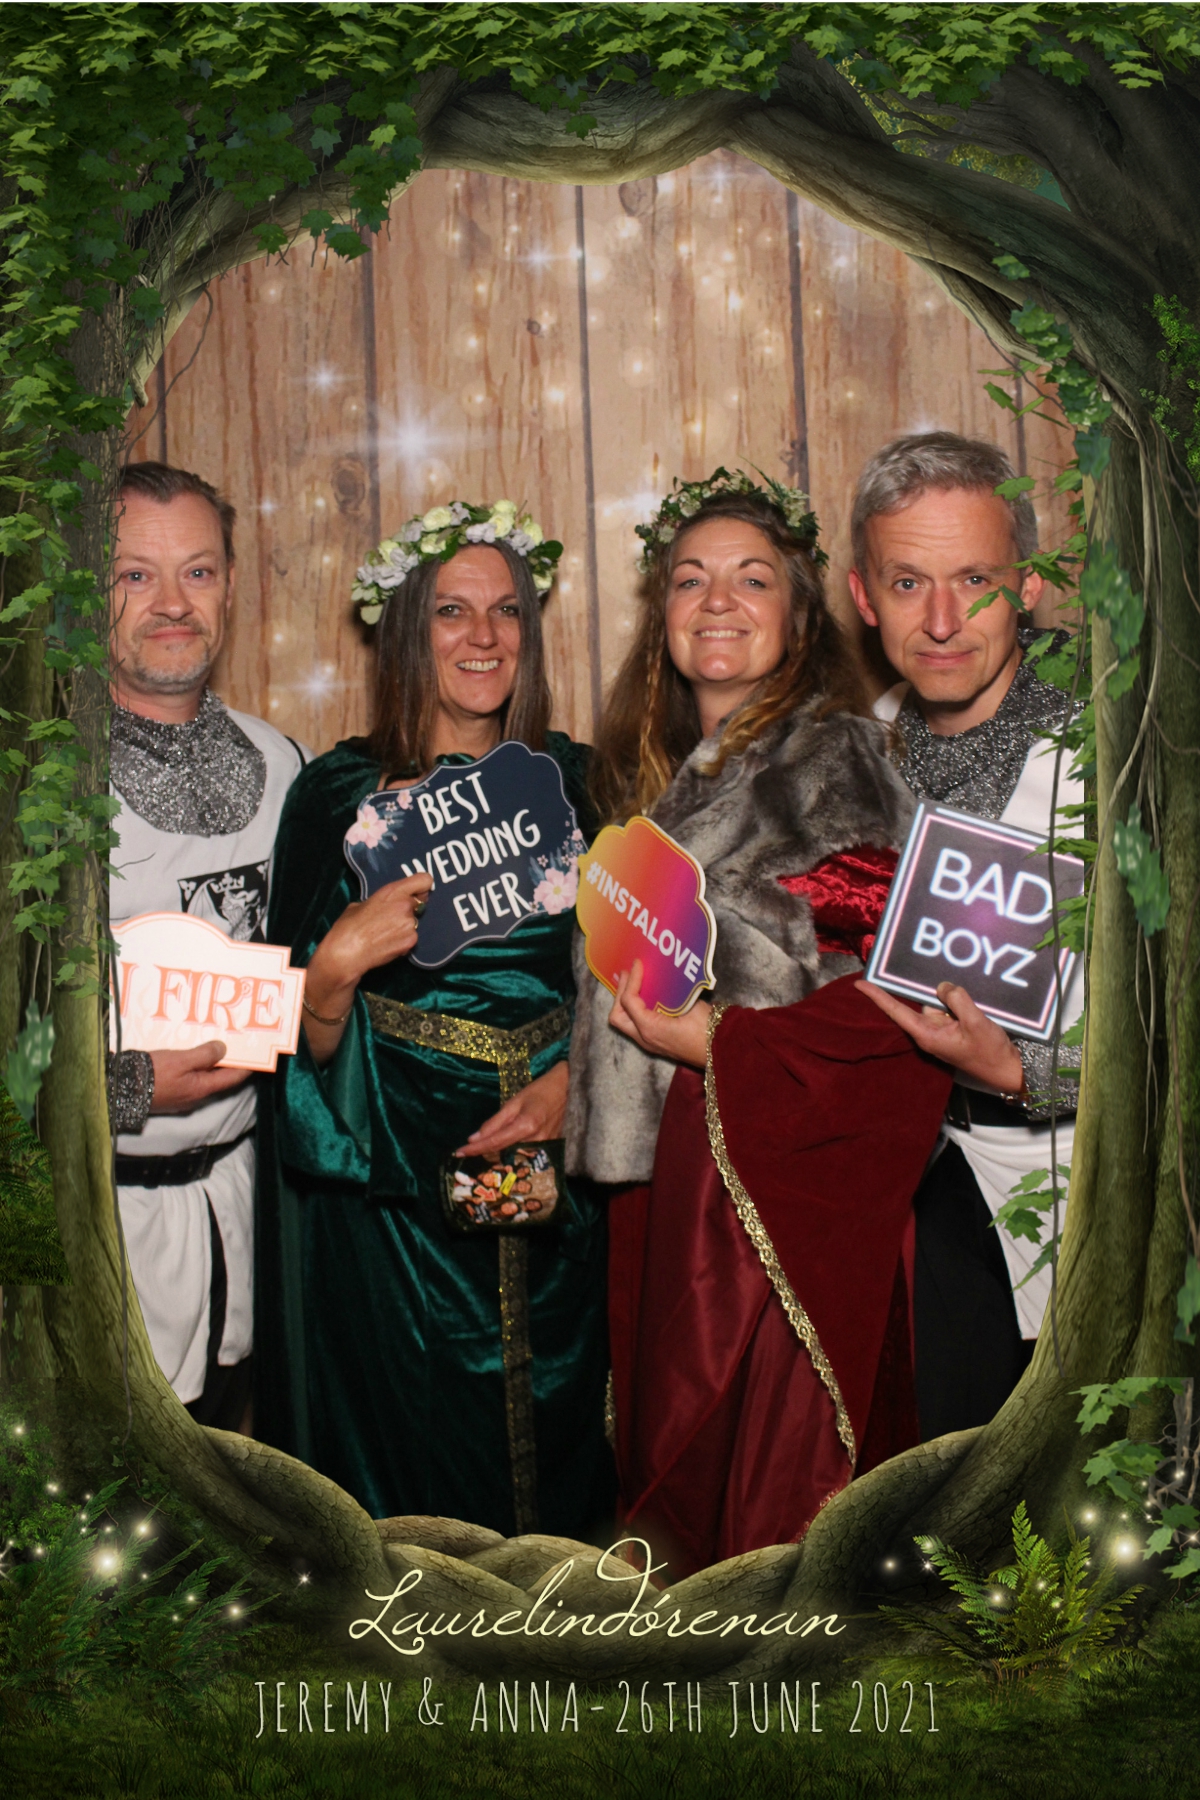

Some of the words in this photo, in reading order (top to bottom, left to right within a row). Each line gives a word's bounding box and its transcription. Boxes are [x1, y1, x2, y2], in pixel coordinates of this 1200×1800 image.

[417, 771, 491, 835] BEST
[401, 809, 541, 891] WEDDING
[929, 847, 1053, 924] BAD
[453, 872, 532, 932] EVER
[586, 861, 702, 983] #INSTALOVE
[912, 916, 1037, 987] BOYZ
[152, 963, 284, 1034] FIRE
